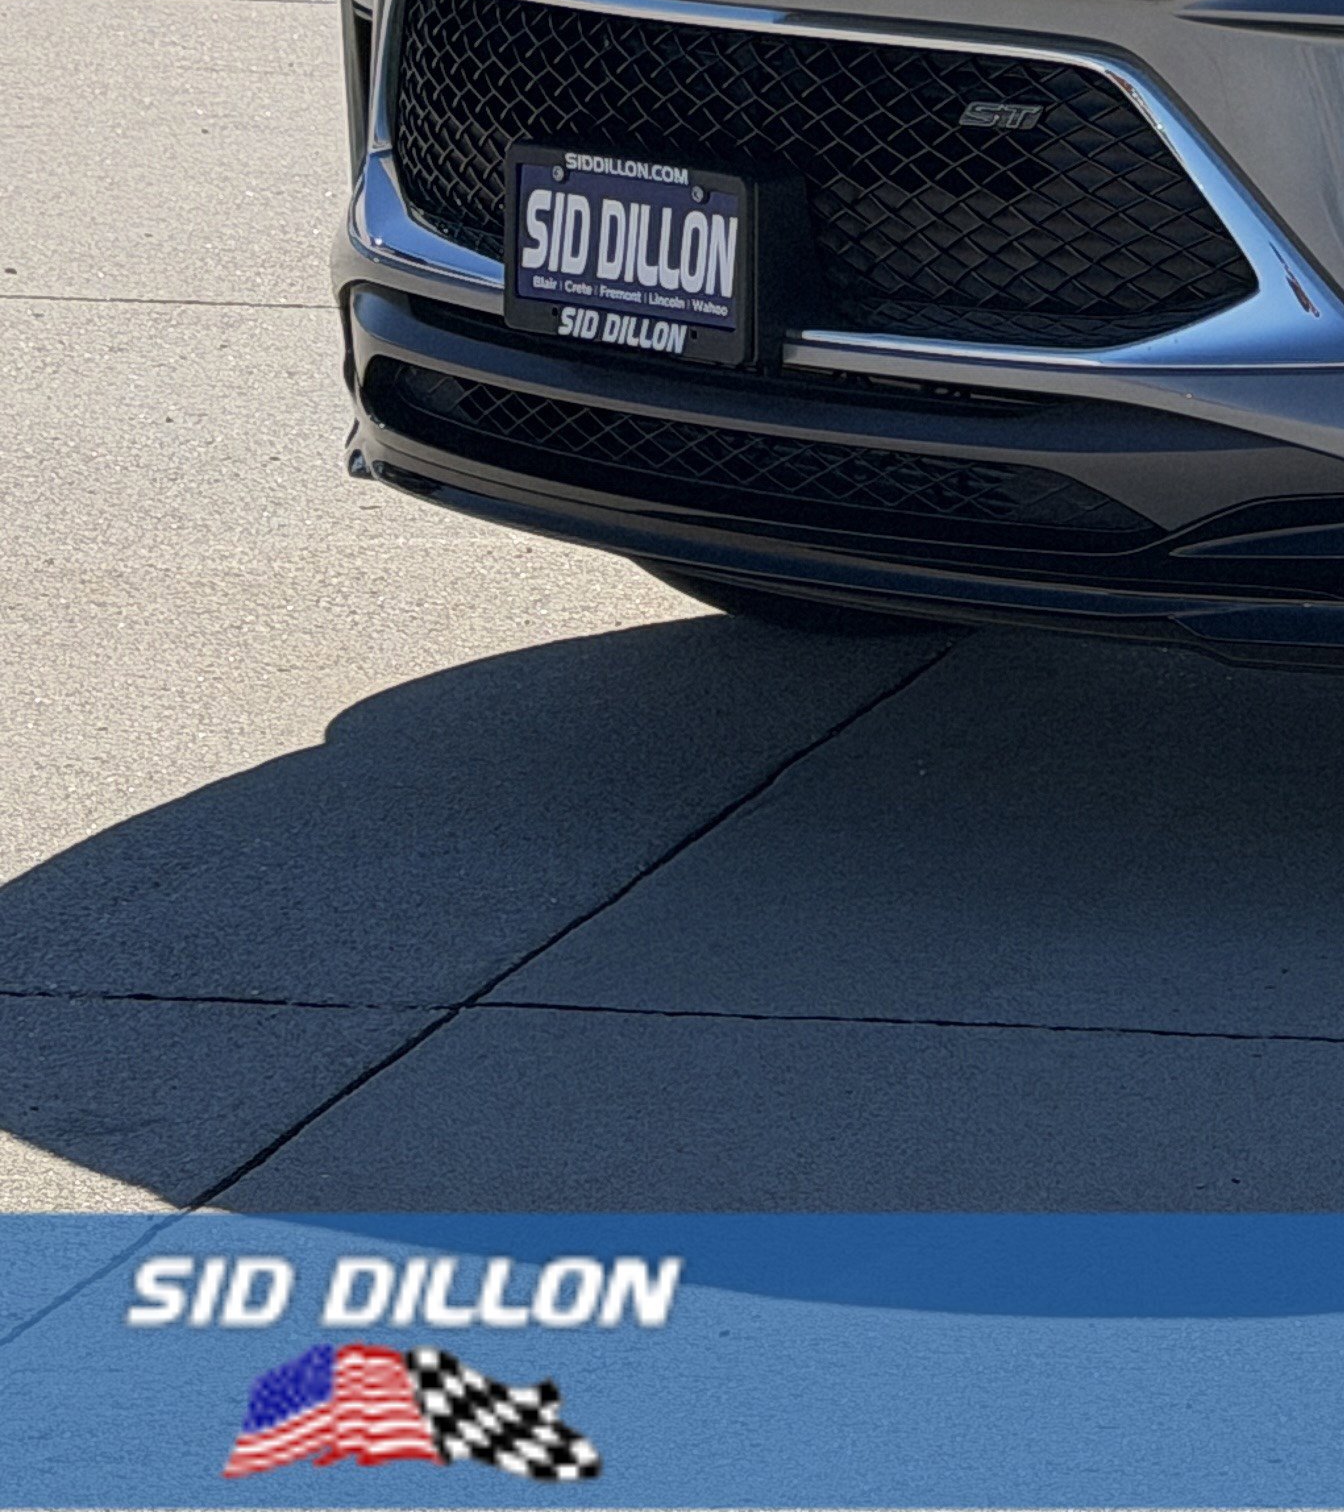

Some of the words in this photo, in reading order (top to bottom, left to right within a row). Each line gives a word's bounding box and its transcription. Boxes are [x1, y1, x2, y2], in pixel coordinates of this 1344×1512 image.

[958, 100, 1043, 130] ST
[564, 152, 689, 186] SIDDILLON.COM
[521, 188, 591, 275] SID
[596, 198, 739, 299] DILLON
[599, 285, 642, 304] Fremont
[691, 298, 729, 317] Wahoo
[557, 306, 599, 340] SID
[602, 313, 689, 355] DILLON
